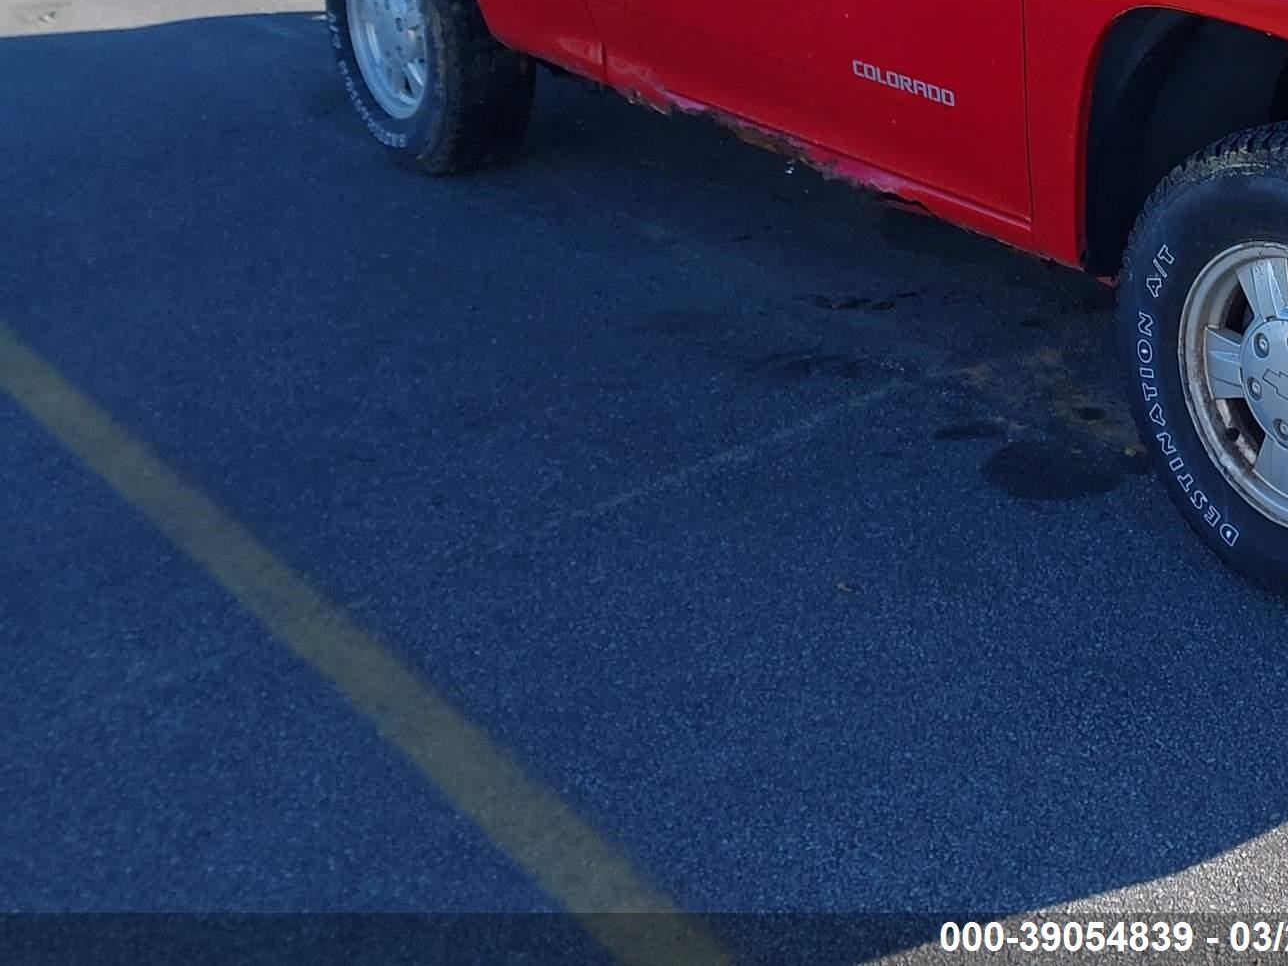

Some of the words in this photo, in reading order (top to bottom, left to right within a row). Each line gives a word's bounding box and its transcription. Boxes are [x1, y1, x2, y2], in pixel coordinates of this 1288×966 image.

[852, 59, 955, 107] COLORADO
[1146, 244, 1175, 298] A/T
[1138, 311, 1239, 547] DESTINATION
